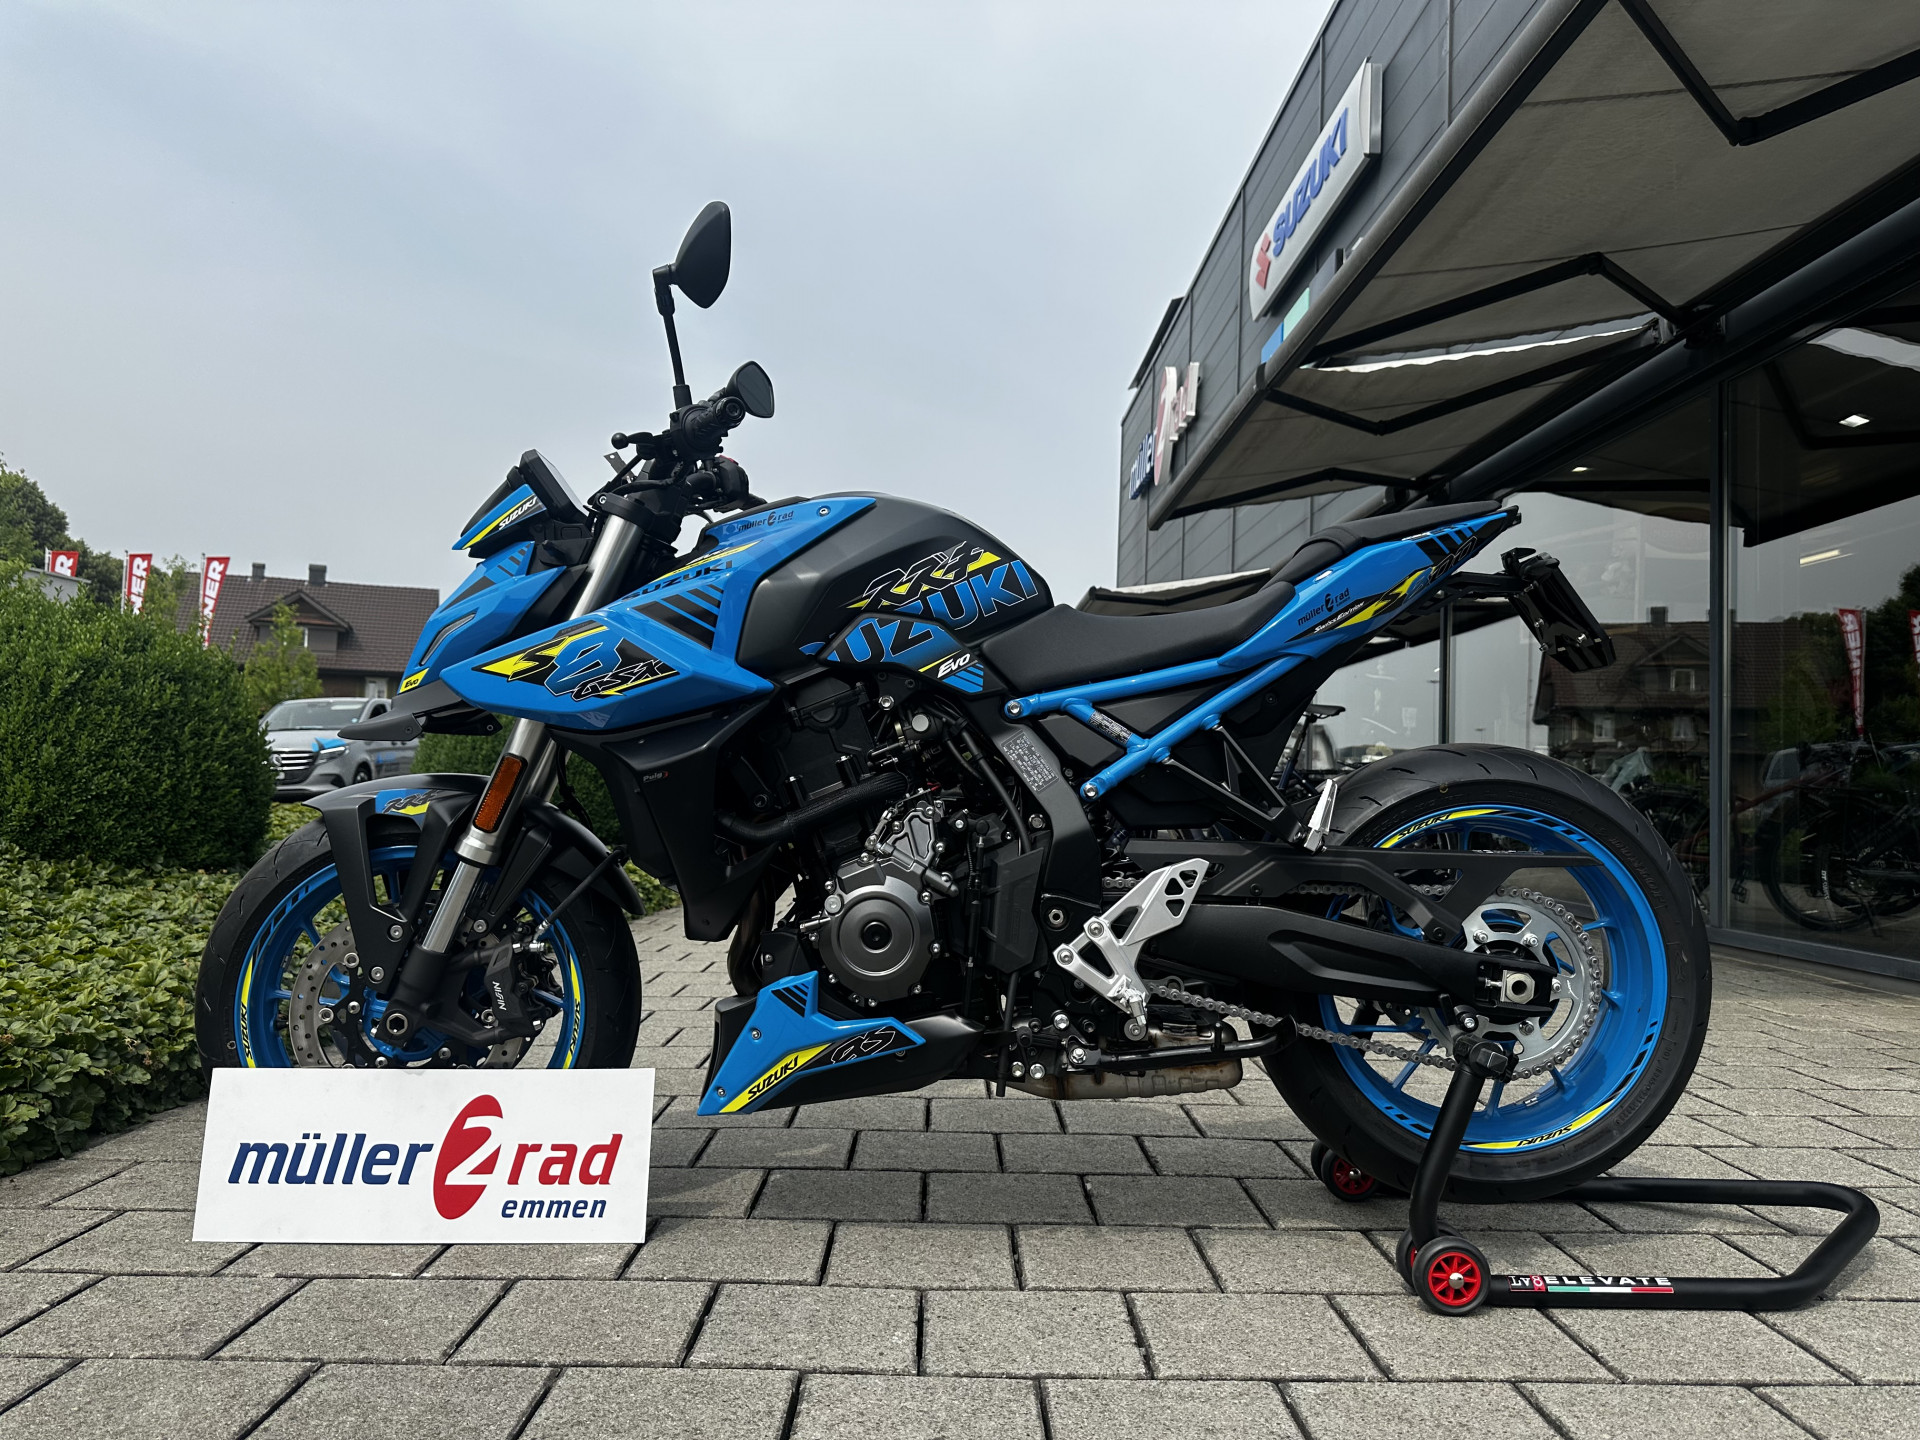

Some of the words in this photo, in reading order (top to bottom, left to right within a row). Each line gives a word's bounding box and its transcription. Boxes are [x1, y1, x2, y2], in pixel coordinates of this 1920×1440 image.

[1273, 107, 1348, 258] SUZUKI
[498, 497, 538, 530] SUZUKI
[619, 560, 733, 602] SUZUKI
[799, 560, 1038, 664] UZUKI
[1398, 813, 1451, 840] SUZUKI
[241, 1002, 254, 1060] SUZUKI
[559, 998, 580, 1055] SUZUKI
[747, 1056, 799, 1101] SUZUKI
[1516, 1124, 1573, 1147] SUZUKI
[501, 1199, 607, 1219] emmen
[1544, 1275, 1672, 1286] ELEVATE
